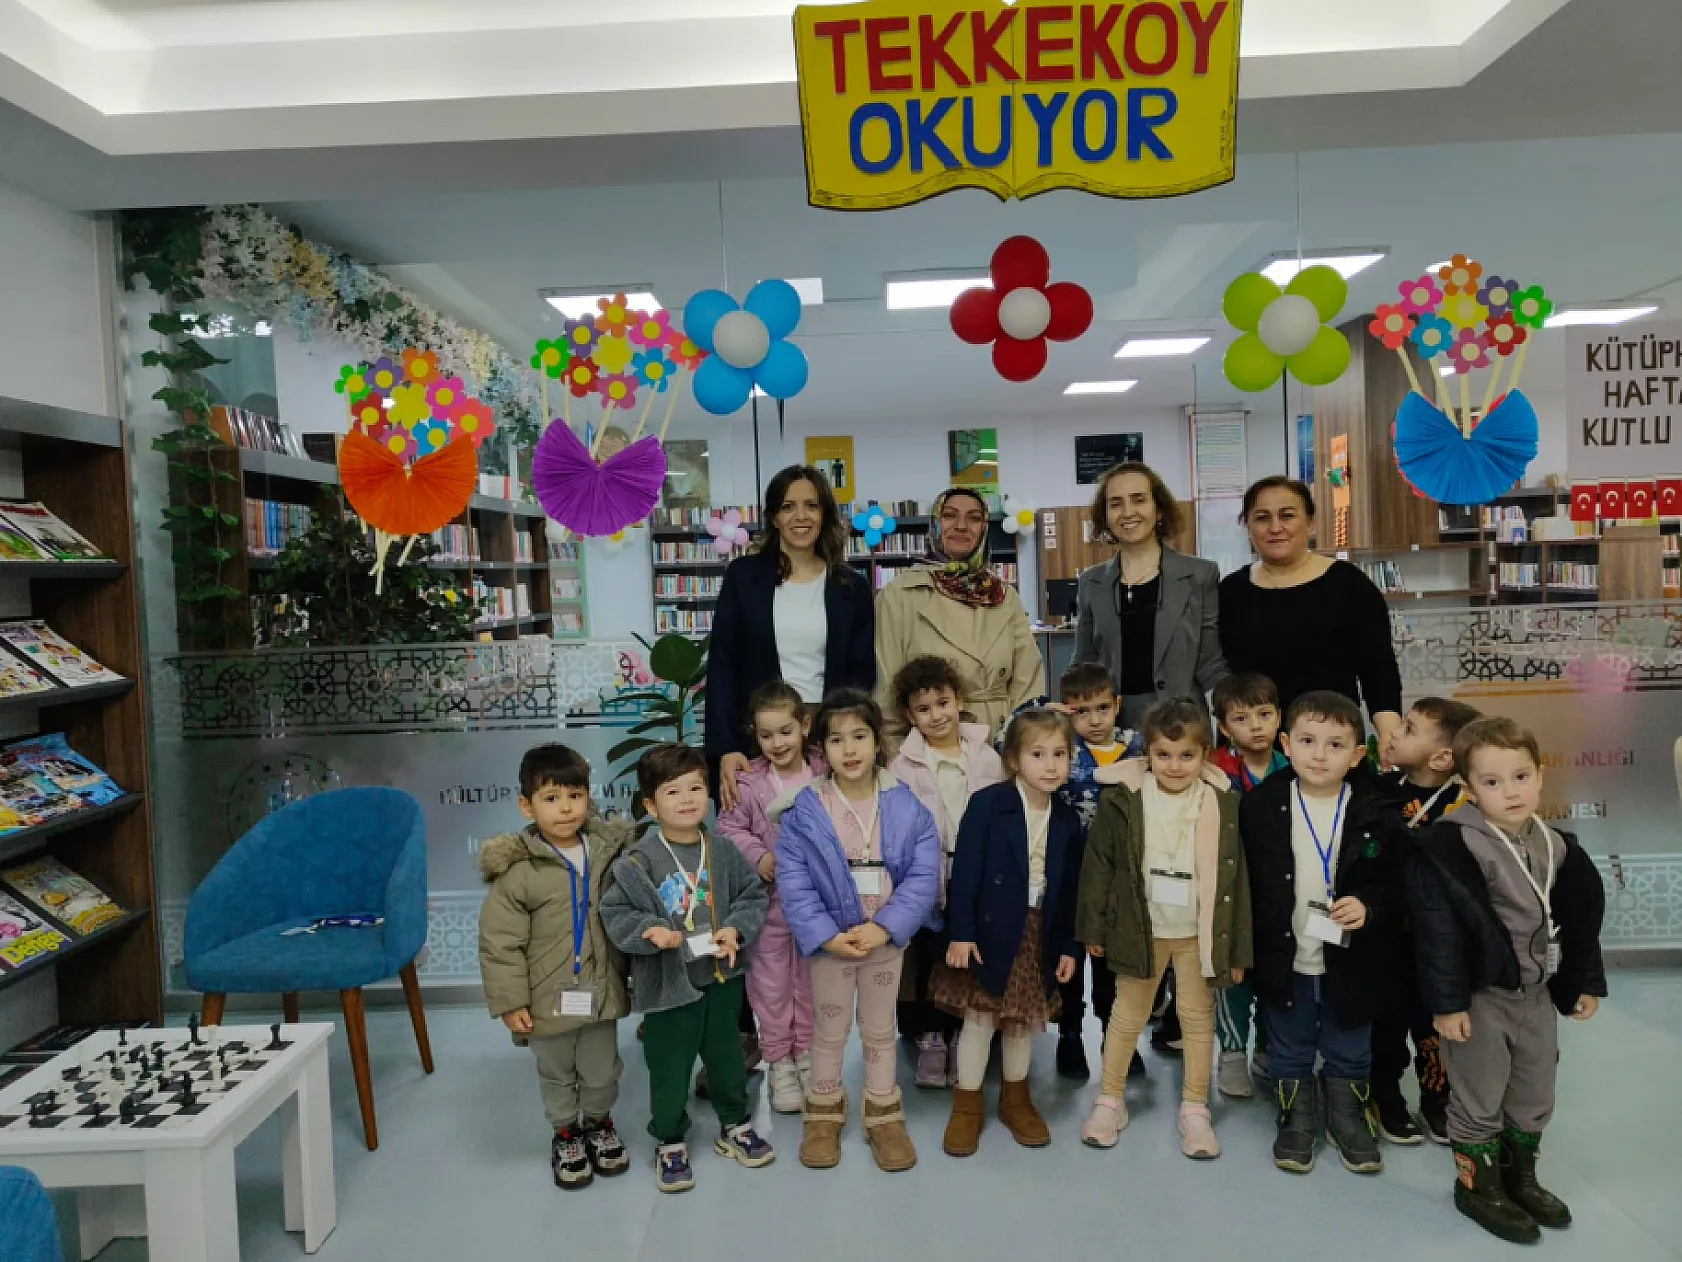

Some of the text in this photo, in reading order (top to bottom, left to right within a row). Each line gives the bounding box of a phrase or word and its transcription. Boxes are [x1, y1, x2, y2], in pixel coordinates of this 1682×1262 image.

[849, 87, 1178, 175] OKUYOR
[1605, 376, 1682, 408] HAFT
[1583, 416, 1671, 446] KUTLU
